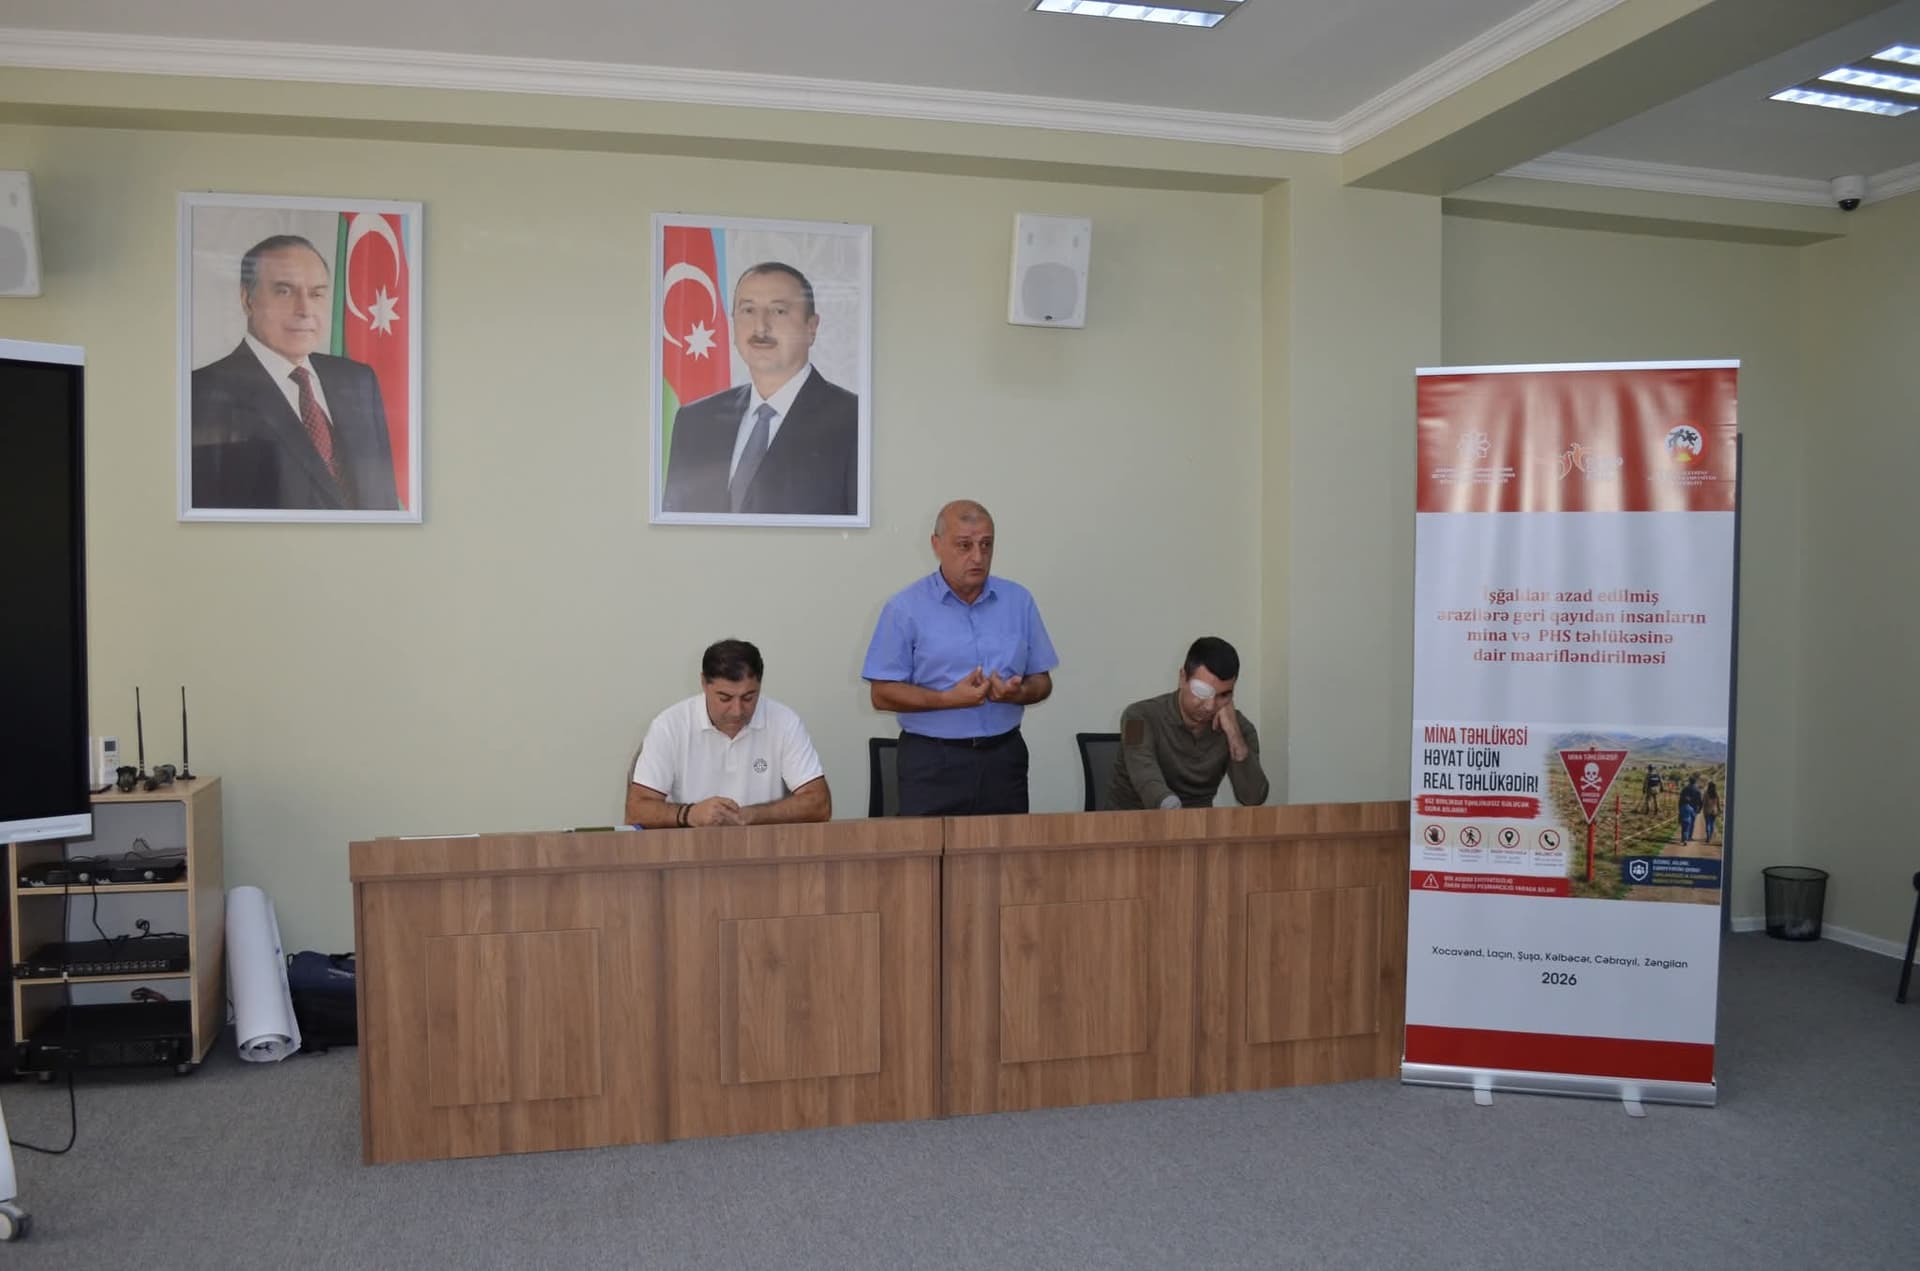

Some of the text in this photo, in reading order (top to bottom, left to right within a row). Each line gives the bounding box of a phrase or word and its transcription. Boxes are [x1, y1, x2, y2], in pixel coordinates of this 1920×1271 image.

[1555, 589, 1592, 602] azad
[1513, 609, 1545, 625] geri
[1551, 609, 1615, 625] qayıdan
[1620, 610, 1706, 624] insanların
[1467, 629, 1673, 644] mina və PHS təhlükəsinə
[1473, 649, 1666, 664] dair maarifləndirilməsi
[1424, 724, 1528, 746] MİNA TƏHLÜKƏSİ
[1424, 747, 1500, 770] HƏYAT ÜÇÜN
[1423, 771, 1539, 793] REAL TƏHLÜKƏDİR!
[1644, 958, 1688, 969] Zəngilan
[1541, 971, 1577, 986] 2026
